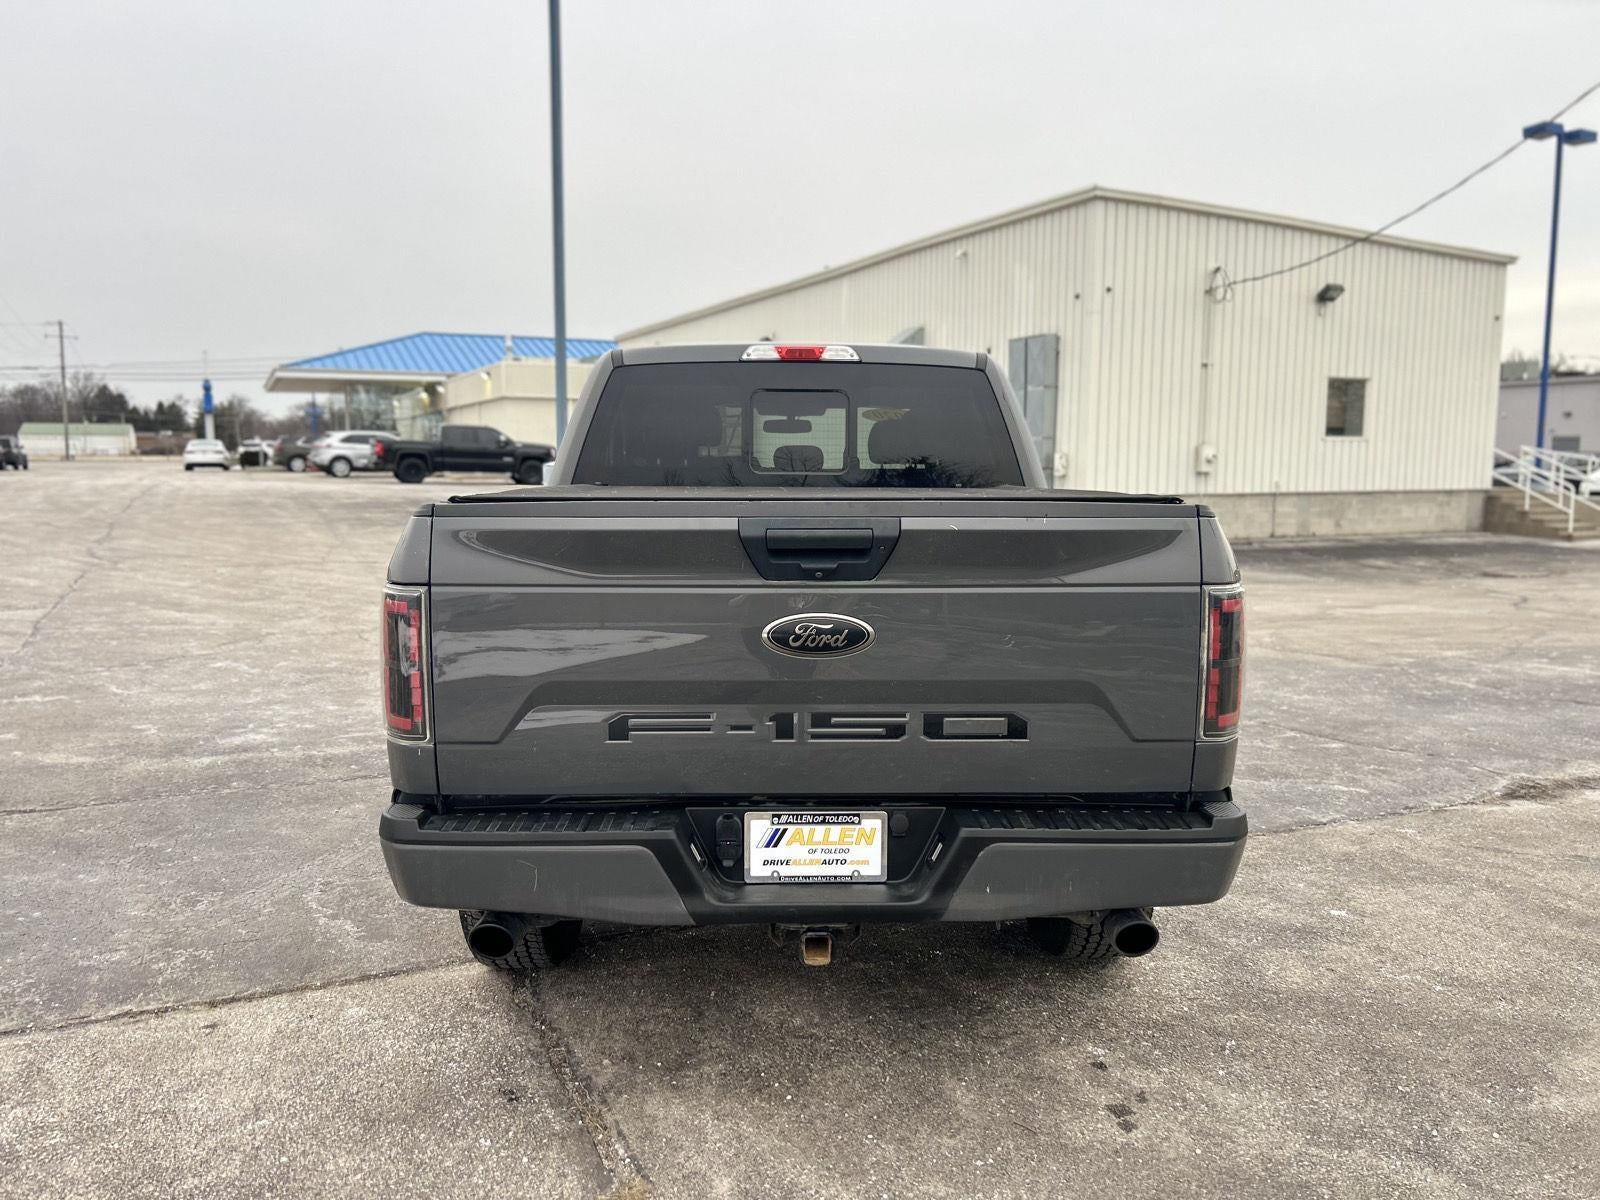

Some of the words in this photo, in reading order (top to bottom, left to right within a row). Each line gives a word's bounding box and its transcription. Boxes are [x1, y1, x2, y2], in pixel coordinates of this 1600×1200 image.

[788, 622, 849, 648] Ford
[604, 711, 1030, 743] F-150
[787, 815, 813, 823] ALLEN
[813, 815, 824, 823] OF
[825, 815, 854, 823] TOLEDO
[786, 827, 876, 846] ALLEN
[762, 858, 870, 866] DRIVEALLENAUTO.com
